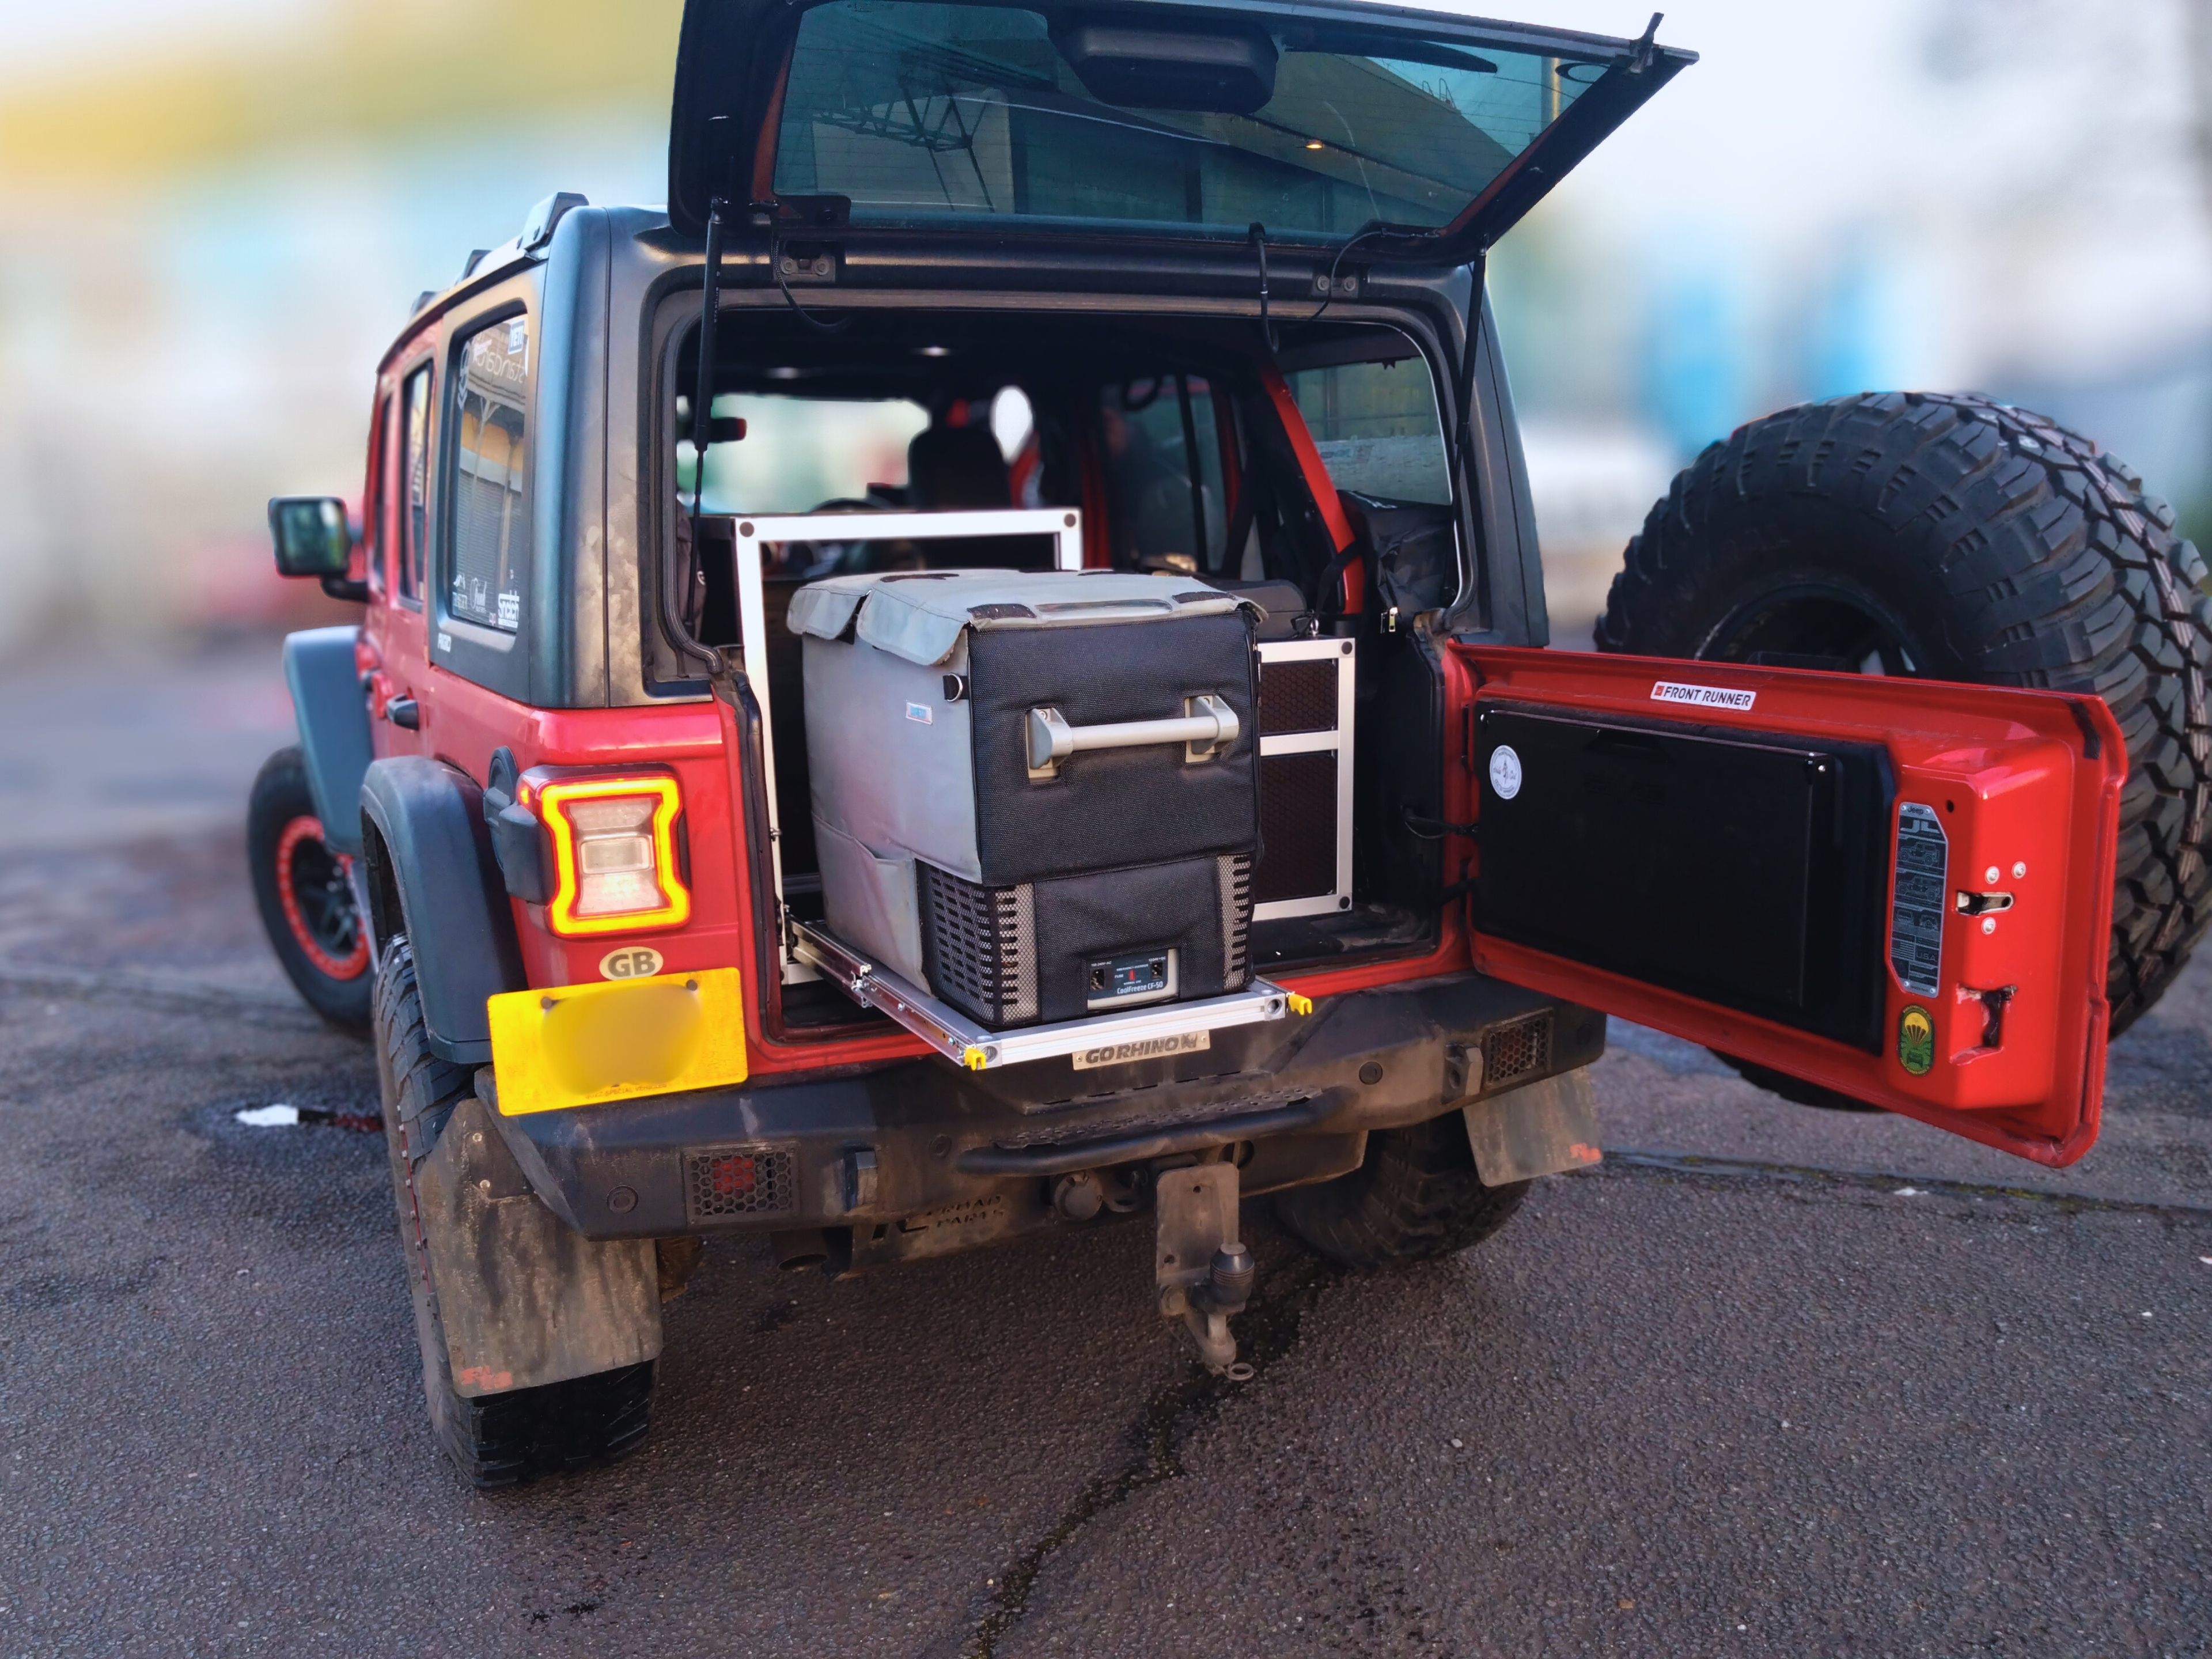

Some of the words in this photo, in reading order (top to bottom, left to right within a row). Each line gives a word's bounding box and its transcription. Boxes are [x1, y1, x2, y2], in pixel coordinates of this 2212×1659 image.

[1664, 686, 1702, 701] FRONT
[1702, 691, 1751, 706] RUNNER
[1907, 806, 1923, 815] Jeep
[608, 950, 656, 977] GB
[1117, 985, 1147, 994] CoolFreeze
[1147, 981, 1163, 990] CF-50
[605, 1087, 633, 1097] SPECIAL
